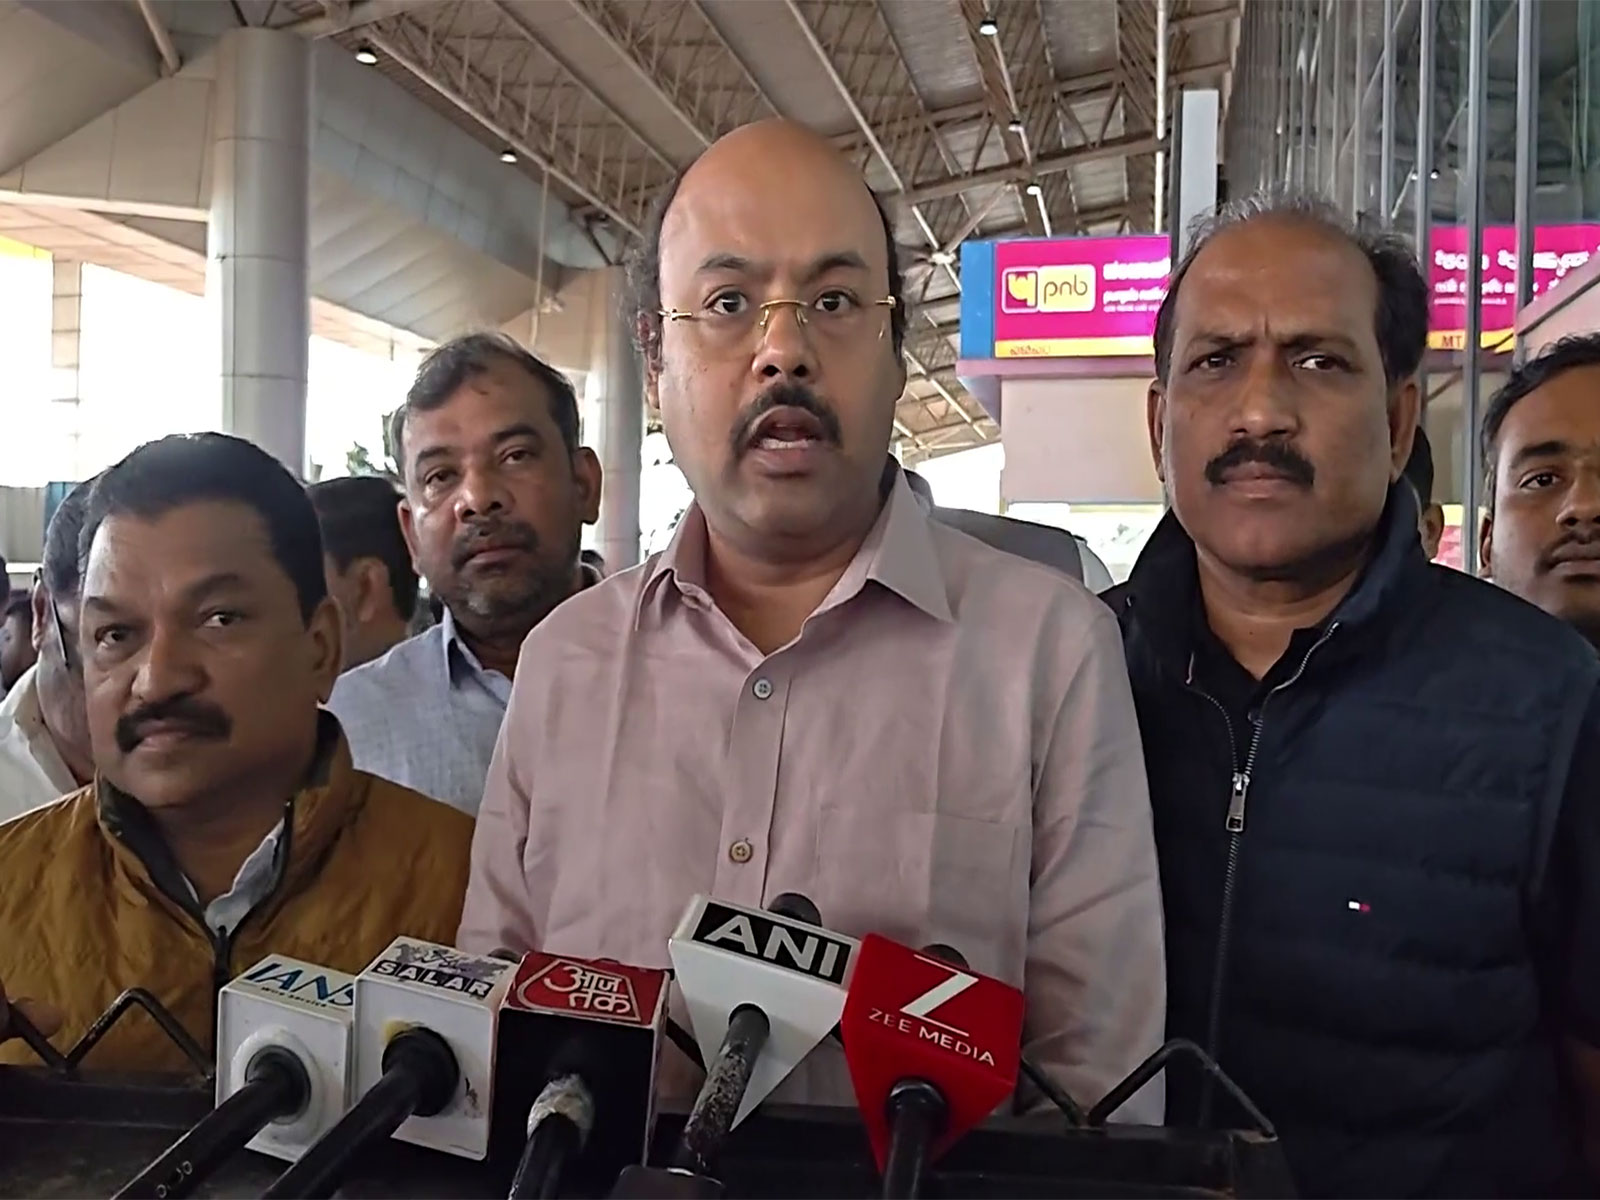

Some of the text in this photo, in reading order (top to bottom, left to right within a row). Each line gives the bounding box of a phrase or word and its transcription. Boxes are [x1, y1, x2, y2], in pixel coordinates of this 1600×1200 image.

[1043, 274, 1088, 304] pnb
[704, 914, 840, 978] ANI
[243, 963, 354, 1007] IANS
[376, 961, 491, 997] SALAR
[543, 965, 623, 993] आज
[568, 987, 632, 1014] तक
[868, 1007, 996, 1067] ZEE MEDIA
